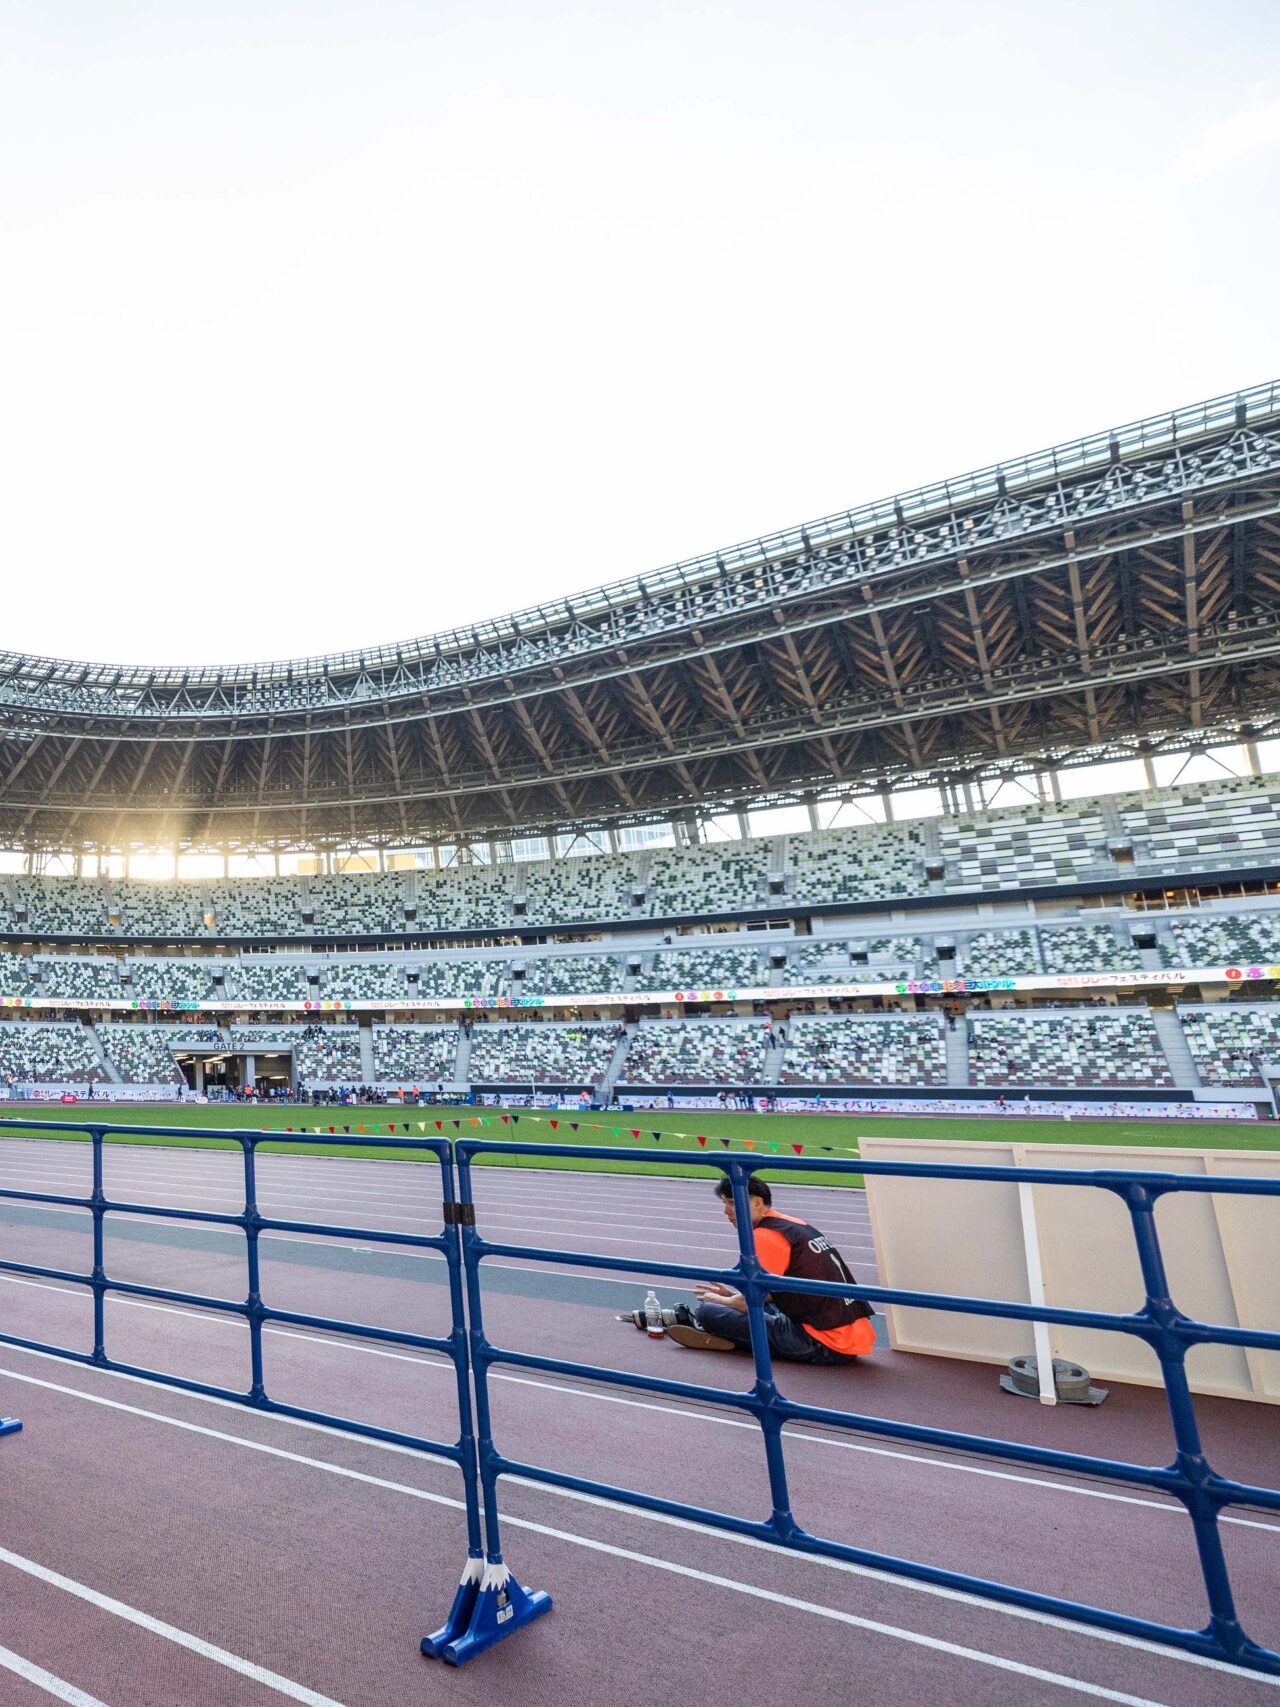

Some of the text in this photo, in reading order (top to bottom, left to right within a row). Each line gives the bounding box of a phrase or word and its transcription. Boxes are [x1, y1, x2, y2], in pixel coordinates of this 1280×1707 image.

[1081, 973, 1186, 985] リレーフェスティバル
[213, 1042, 245, 1051] GATE 2
